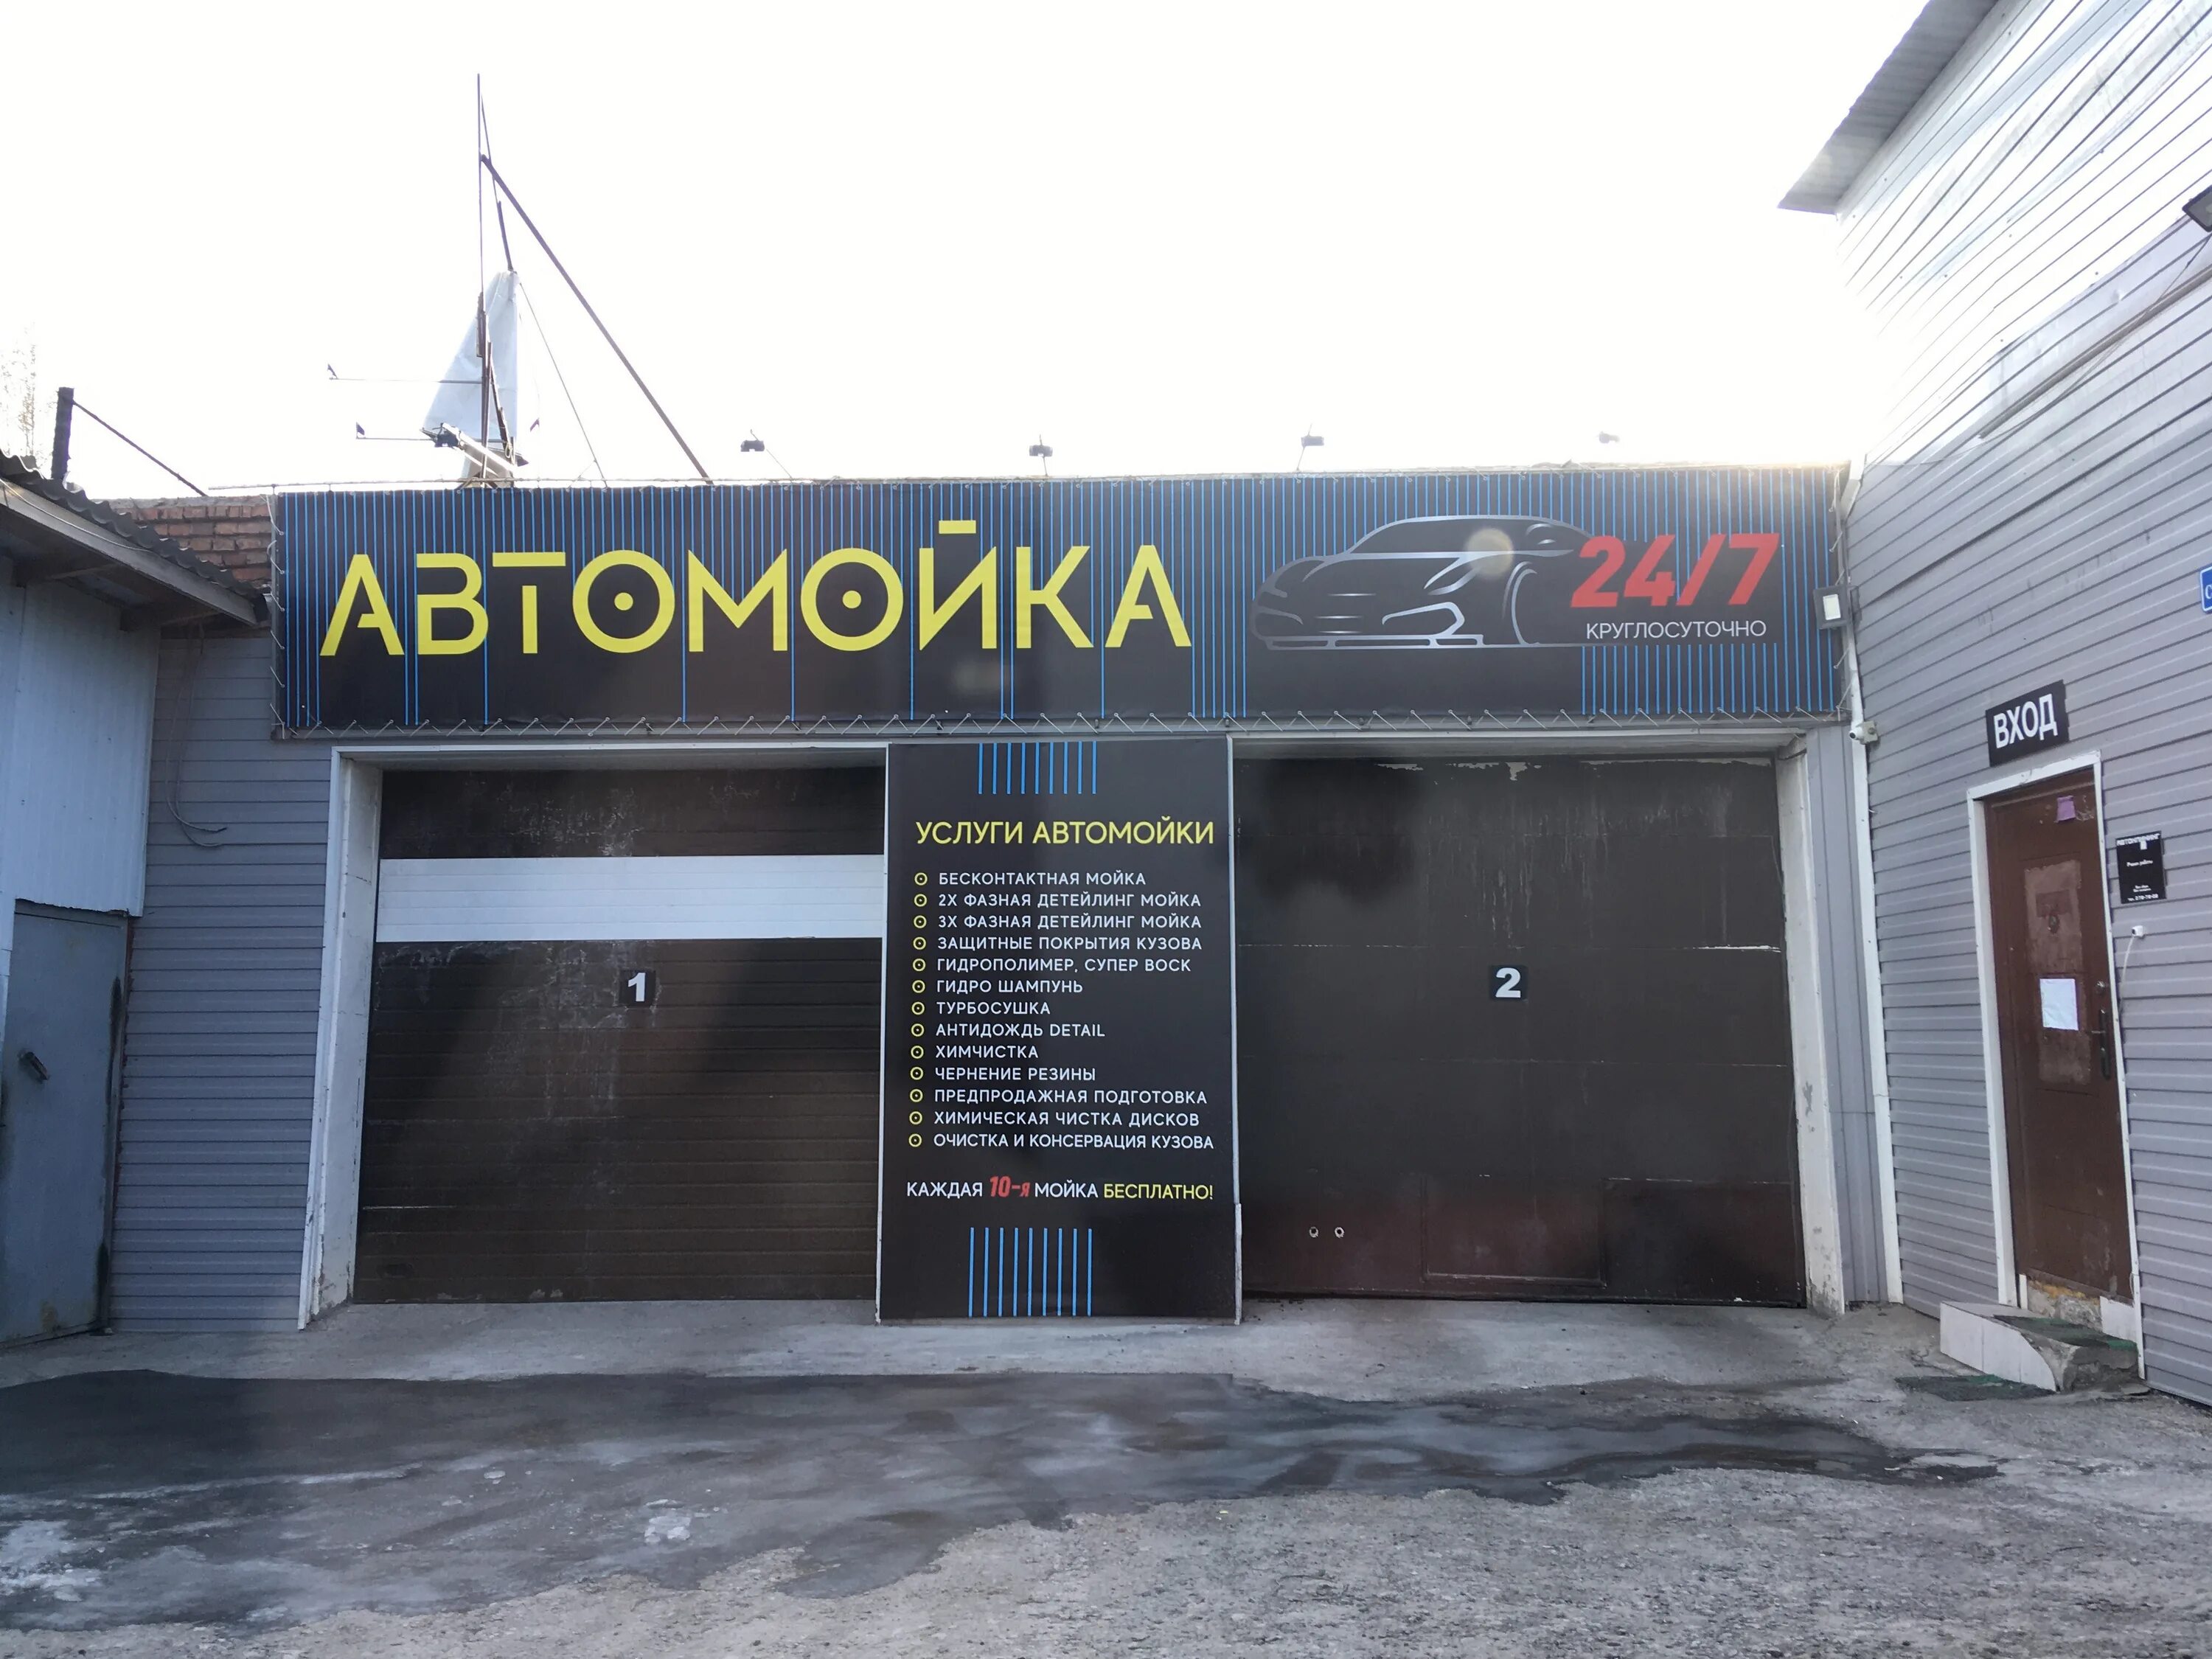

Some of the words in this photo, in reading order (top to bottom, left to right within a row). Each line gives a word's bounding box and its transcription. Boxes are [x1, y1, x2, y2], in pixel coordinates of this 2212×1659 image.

[1570, 532, 1780, 608] 24/7
[320, 521, 1192, 655] АВТОМОЙКА
[1586, 620, 1767, 639] КРУГЛОСУТОЧНО
[1994, 694, 2058, 748] ВХОД
[916, 821, 1023, 844] УСЛУГИ
[1032, 815, 1214, 844] АВТОМОЙКИ
[939, 872, 1079, 885] БЕСКОНТАКТНАЯ
[1086, 869, 1146, 885] МОЙКА
[964, 893, 1031, 907] ФАЗНАЯ
[1037, 891, 1135, 908] ДЕТЕЙЛИНГ
[1141, 891, 1201, 907] МОЙКА
[964, 914, 1031, 928] ФАЗНАЯ
[1037, 912, 1135, 930] ДЕТЕЙЛИНГ
[1141, 912, 1202, 928] МОЙКА
[938, 936, 1032, 951] ЗАЩИТНЫЕ
[1039, 936, 1130, 950] ПОКРЫТИЯ
[1137, 937, 1202, 950] КУЗОВА
[937, 958, 1078, 973] ГИДРОПОЛИМЕР,
[1085, 959, 1138, 972] СУПЕР
[1145, 959, 1191, 972] ВОСК
[628, 973, 645, 1001] 1
[937, 980, 992, 995] ГИДРО
[998, 980, 1083, 993] ШАМПУНЬ
[1495, 967, 1520, 998] 2
[936, 1001, 1051, 1015] ТУРБОСУШКА
[936, 1023, 1043, 1039] АНТИДОЖДЬ
[1050, 1023, 1105, 1037] DETAIL
[935, 1045, 1039, 1058] ХИМЧИСТКА
[935, 1067, 1021, 1080] ЧЕРНЕНИЕ
[1028, 1067, 1096, 1081] РЕЗИНЫ
[935, 1089, 1088, 1105] ПРЕДПРОДАЖНАЯ
[1094, 1090, 1208, 1105] ПОДГОТОВКА
[933, 1111, 1048, 1125] ХИМИЧЕСКАЯ
[1055, 1112, 1123, 1125] ЧИСТКА
[1128, 1113, 1200, 1128] ДИСКОВ
[933, 1133, 1009, 1147] ОЧИСТКА
[1014, 1134, 1024, 1147] И
[1029, 1134, 1146, 1150] КОНСЕРВАЦИЯ
[1152, 1135, 1214, 1150] КУЗОВА
[907, 1181, 983, 1199] КАЖДАЯ
[1034, 1179, 1099, 1198] МОЙКА
[1104, 1183, 1213, 1200] БЕСПЛАТНО!
